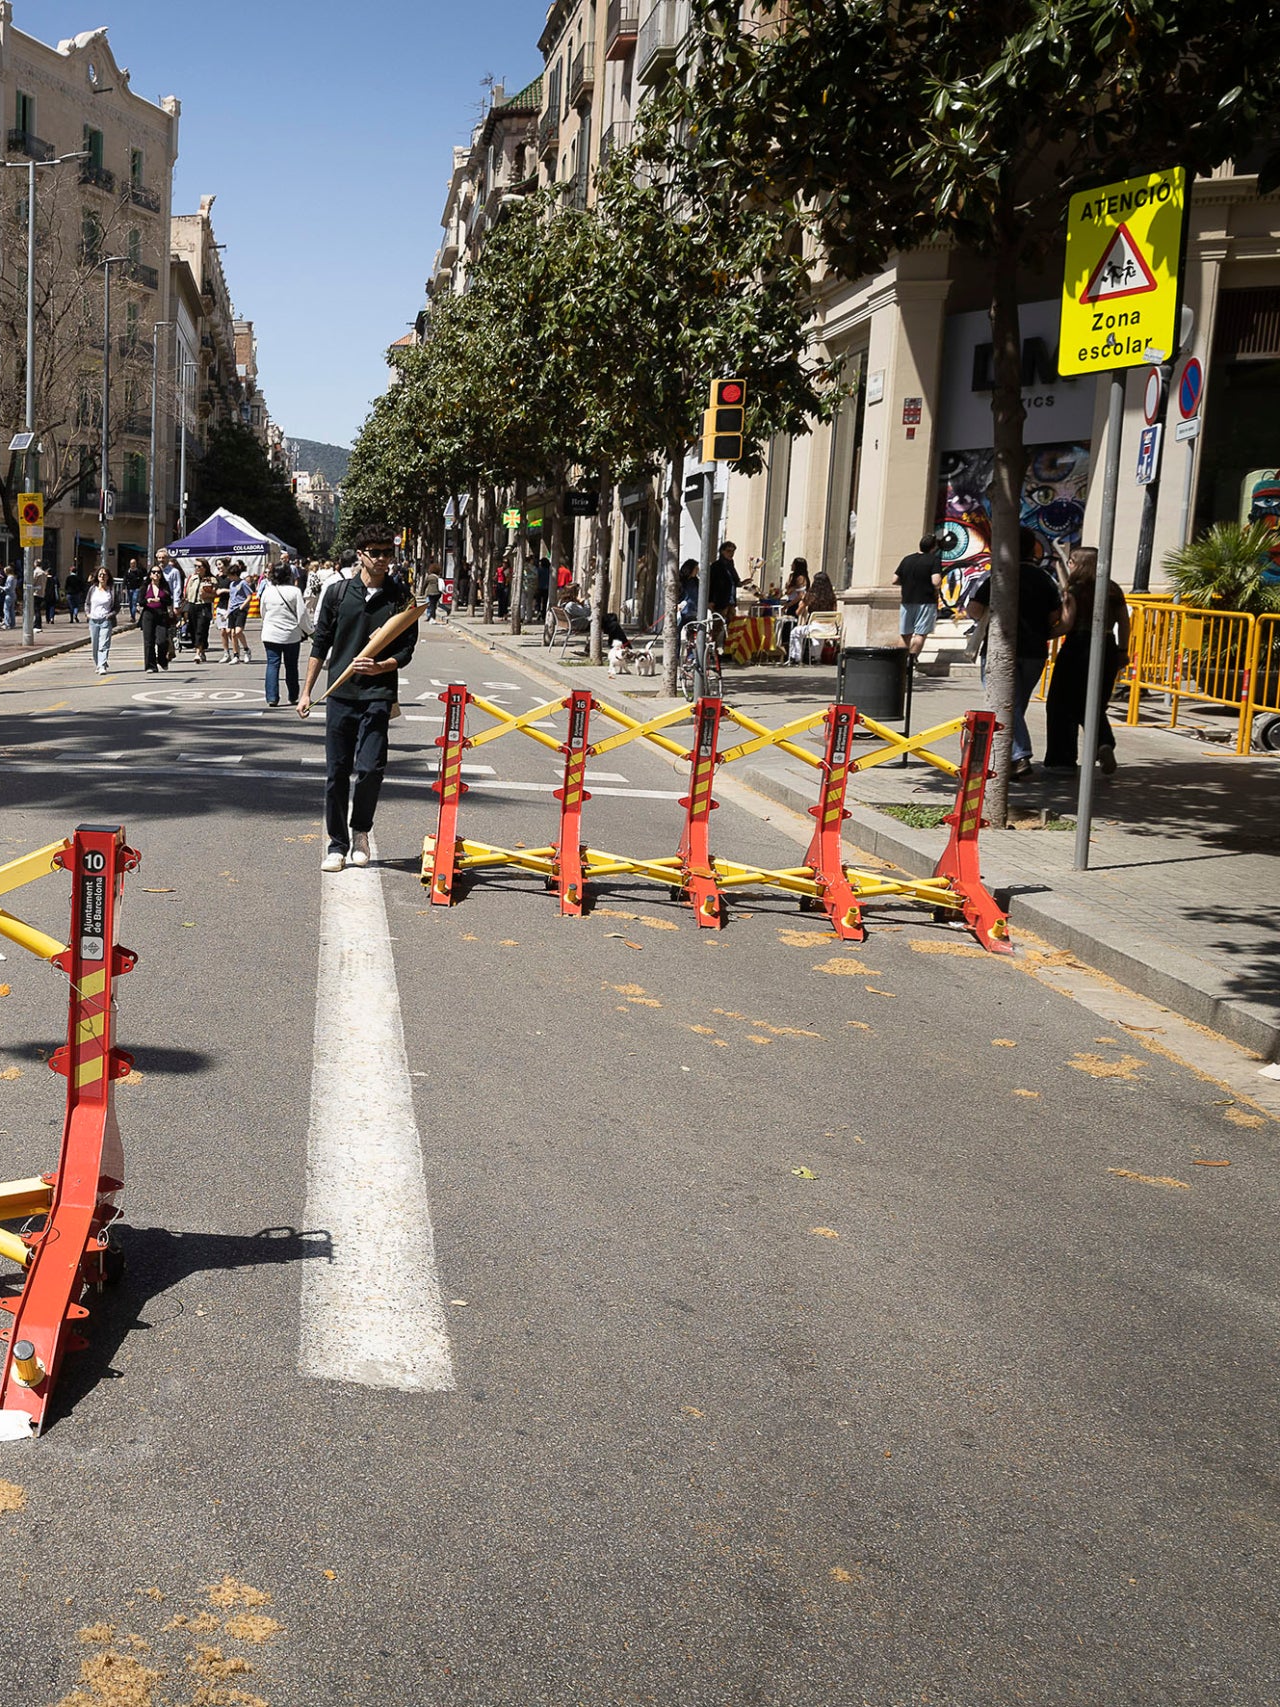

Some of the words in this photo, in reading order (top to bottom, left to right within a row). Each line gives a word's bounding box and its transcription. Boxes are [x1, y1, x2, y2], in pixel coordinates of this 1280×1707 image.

[1081, 178, 1173, 222] ATENCIÓ
[1091, 310, 1141, 332] Zona
[1078, 336, 1153, 362] escolar
[166, 691, 245, 701] 30
[84, 853, 105, 870] 10
[84, 881, 94, 933] Ajuntament
[93, 877, 104, 921] Barcelona
[93, 922, 102, 933] de
